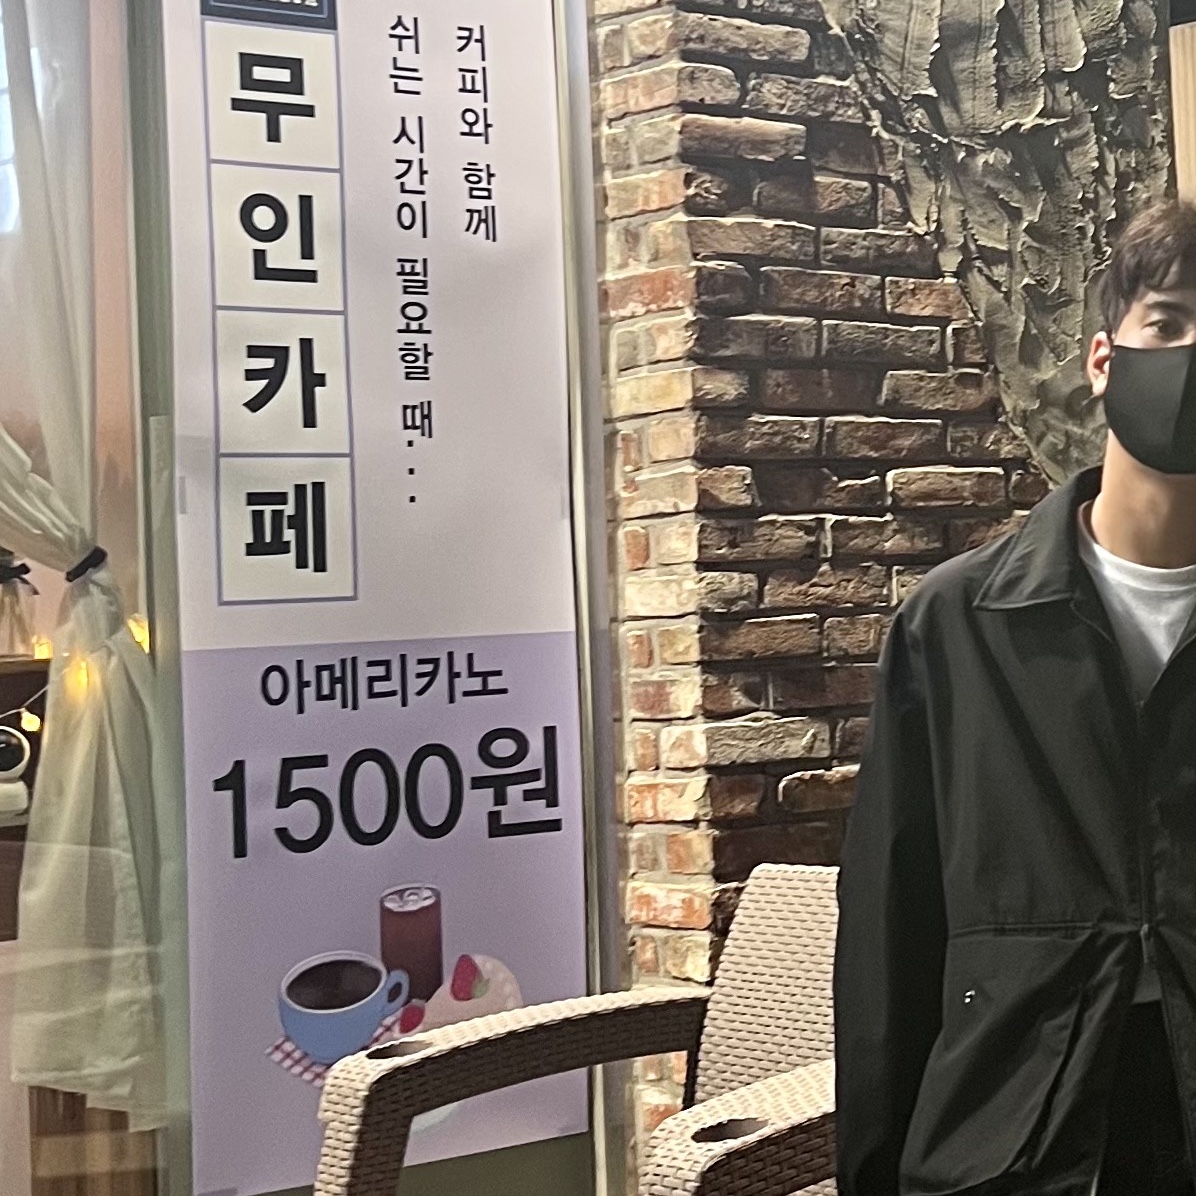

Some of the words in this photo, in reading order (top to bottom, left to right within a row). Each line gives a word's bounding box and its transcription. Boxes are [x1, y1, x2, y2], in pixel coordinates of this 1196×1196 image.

[388, 15, 424, 95] 쉬는
[456, 25, 493, 145] 커피와
[392, 116, 429, 239] 시간이
[462, 162, 497, 242] 함께
[230, 52, 327, 574] 무인카페
[396, 258, 433, 381] 필요할
[261, 651, 509, 715] 아메리카노
[213, 725, 563, 859] 1500원
